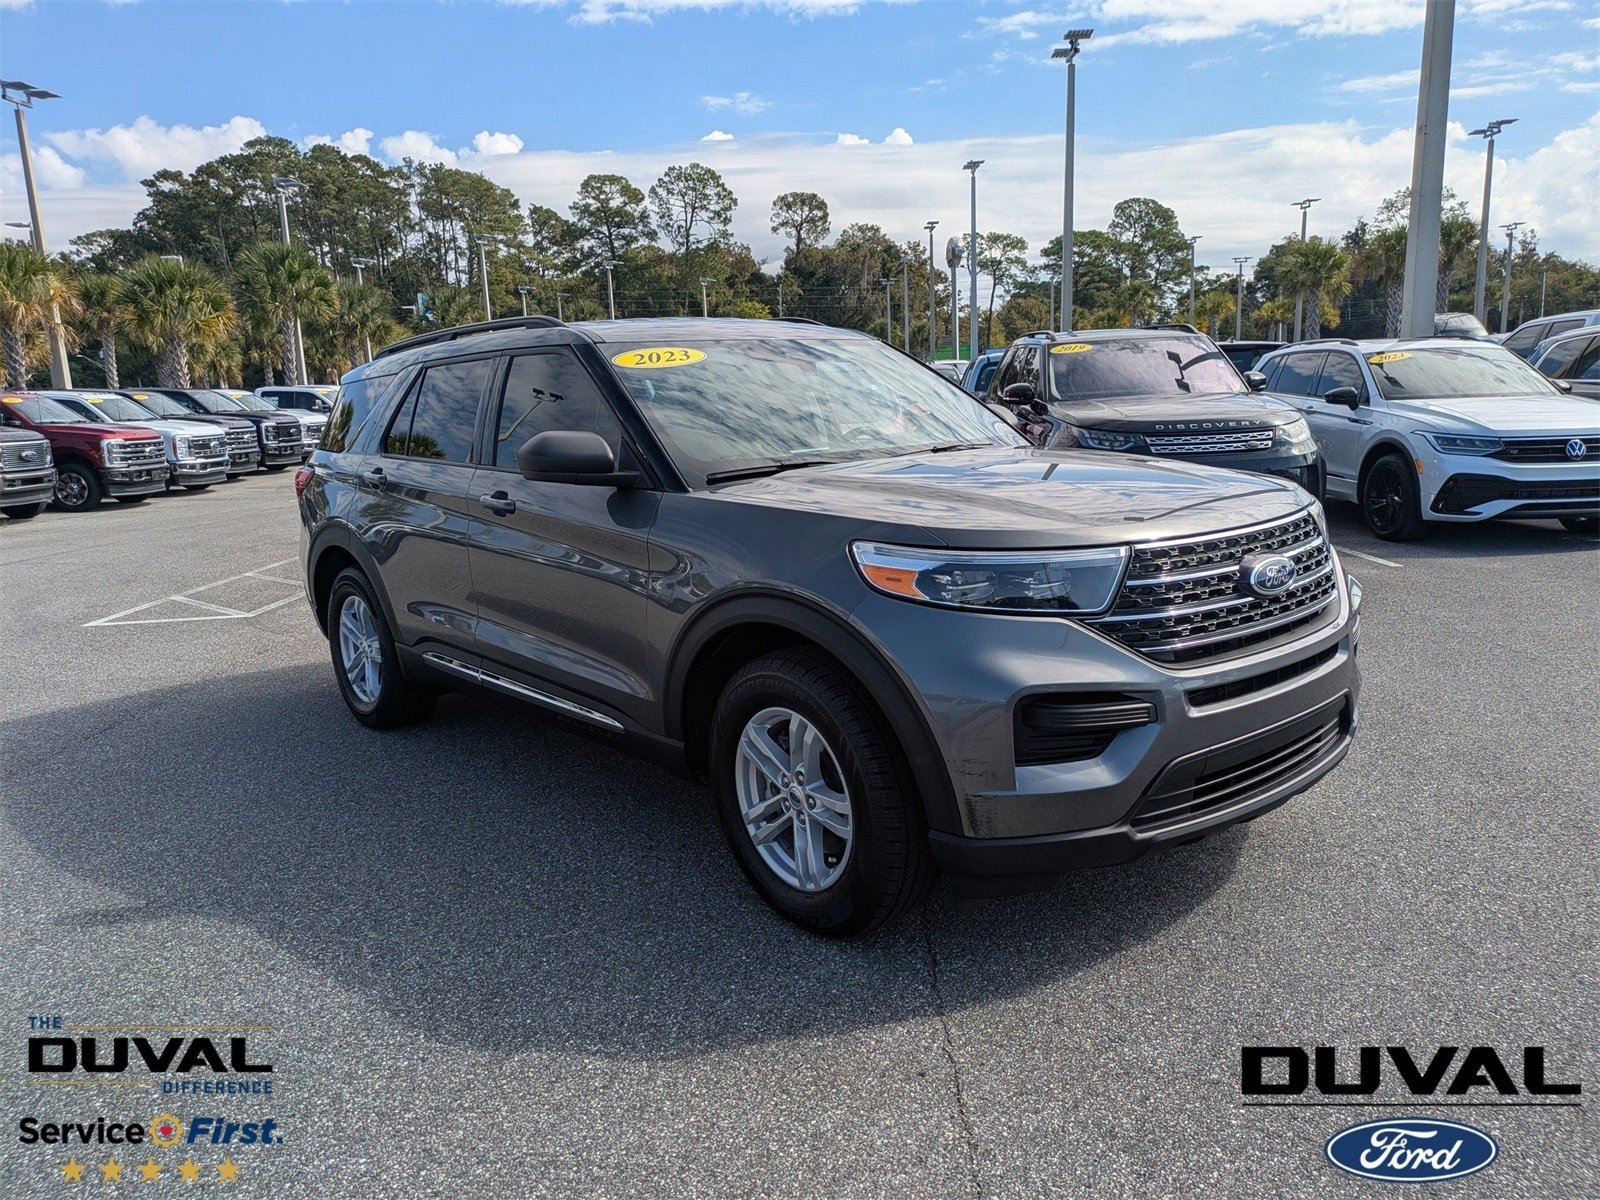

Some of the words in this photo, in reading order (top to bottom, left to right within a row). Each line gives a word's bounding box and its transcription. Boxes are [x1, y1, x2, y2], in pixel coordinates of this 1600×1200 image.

[1056, 344, 1087, 353] 2019
[633, 350, 691, 365] 2023
[1377, 353, 1404, 361] 2023
[1155, 420, 1261, 430] DISCOVERY
